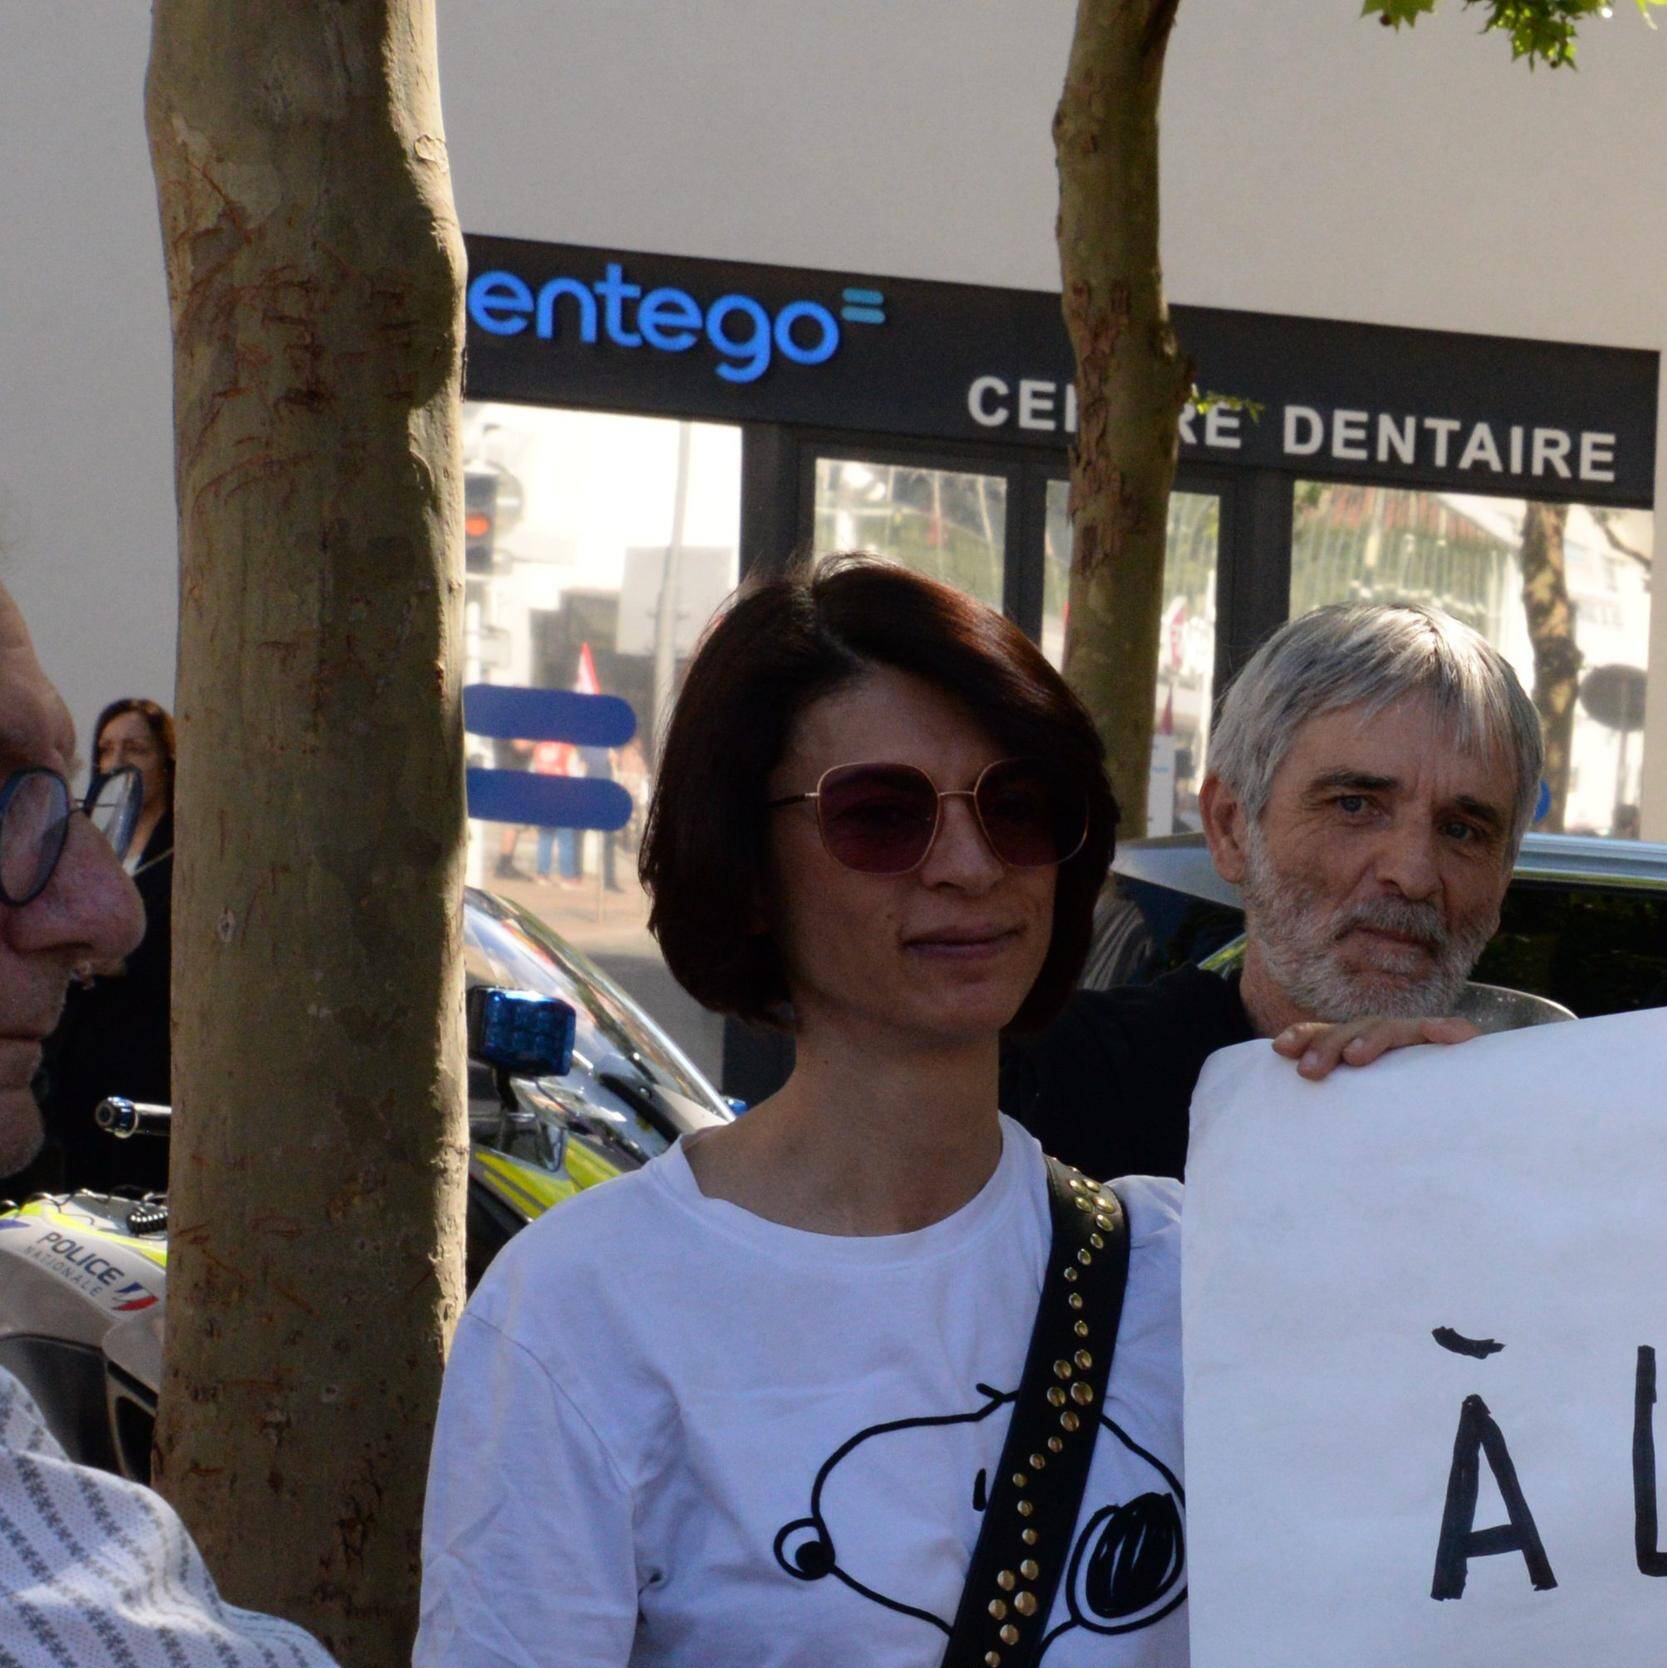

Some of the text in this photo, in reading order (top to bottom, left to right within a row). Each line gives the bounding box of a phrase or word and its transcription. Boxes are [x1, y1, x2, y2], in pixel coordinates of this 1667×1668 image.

[1283, 405, 1617, 483] DENTAIRE
[22, 1245, 103, 1298] NATIONALE
[37, 1231, 125, 1287] POLICE
